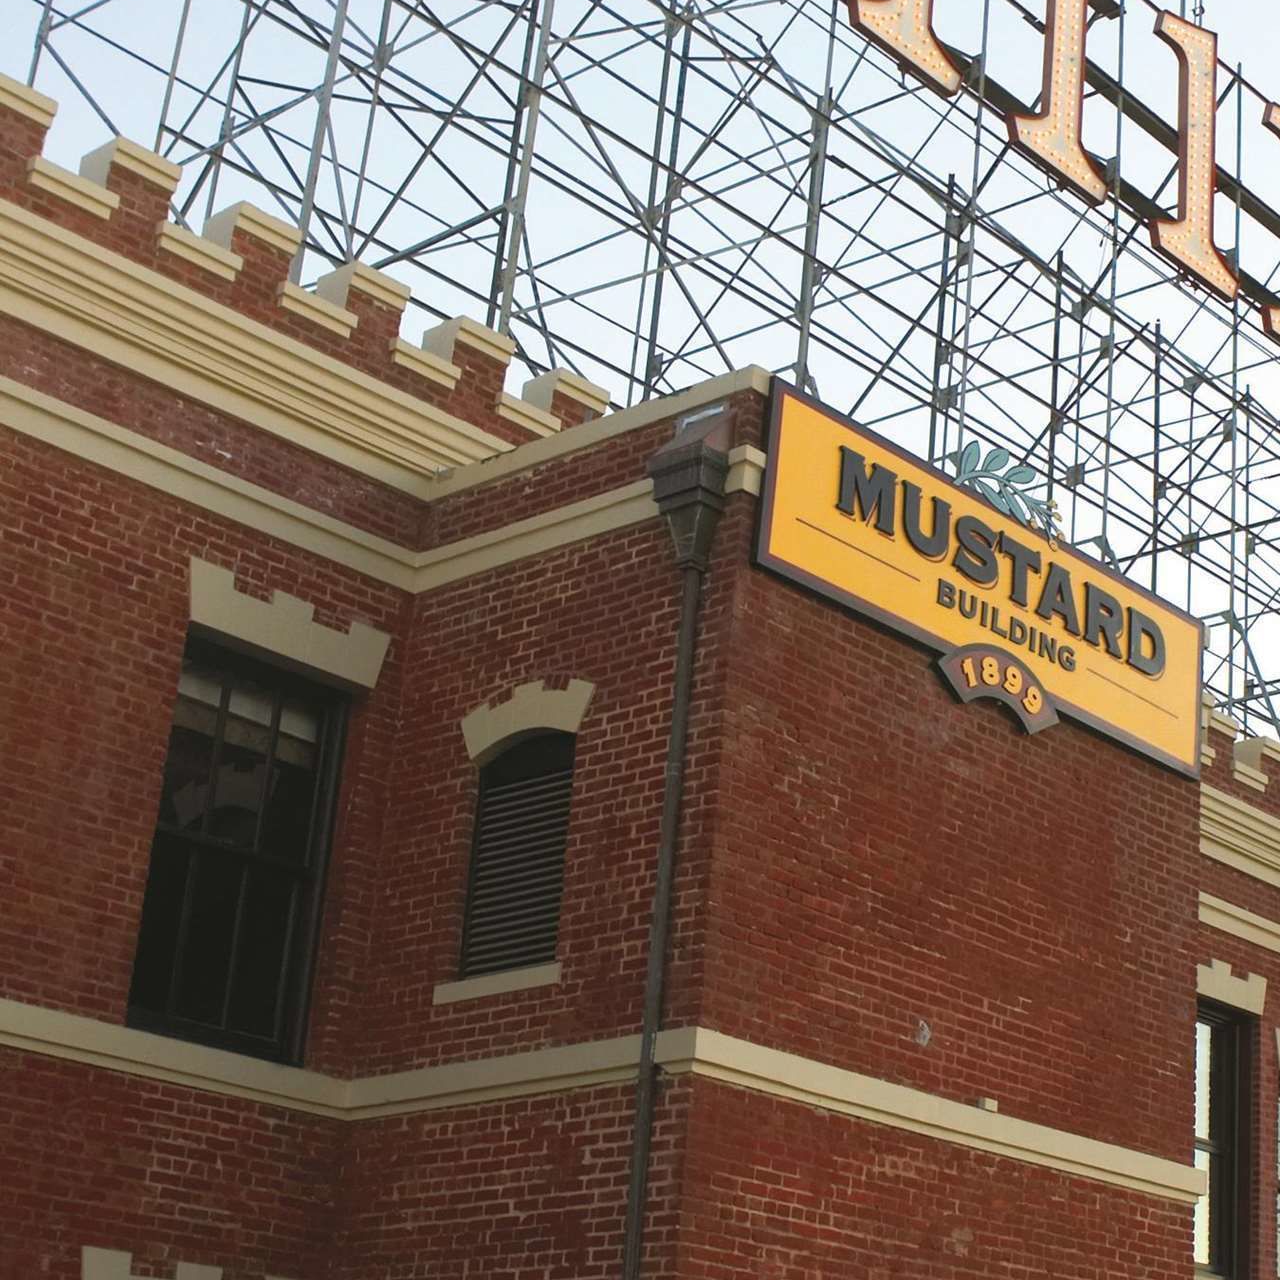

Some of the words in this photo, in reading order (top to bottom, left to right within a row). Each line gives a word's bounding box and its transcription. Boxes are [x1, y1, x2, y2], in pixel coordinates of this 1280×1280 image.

[835, 444, 1167, 679] MUSTARD
[936, 577, 1078, 672] BUILDING
[960, 655, 1044, 716] 1899
